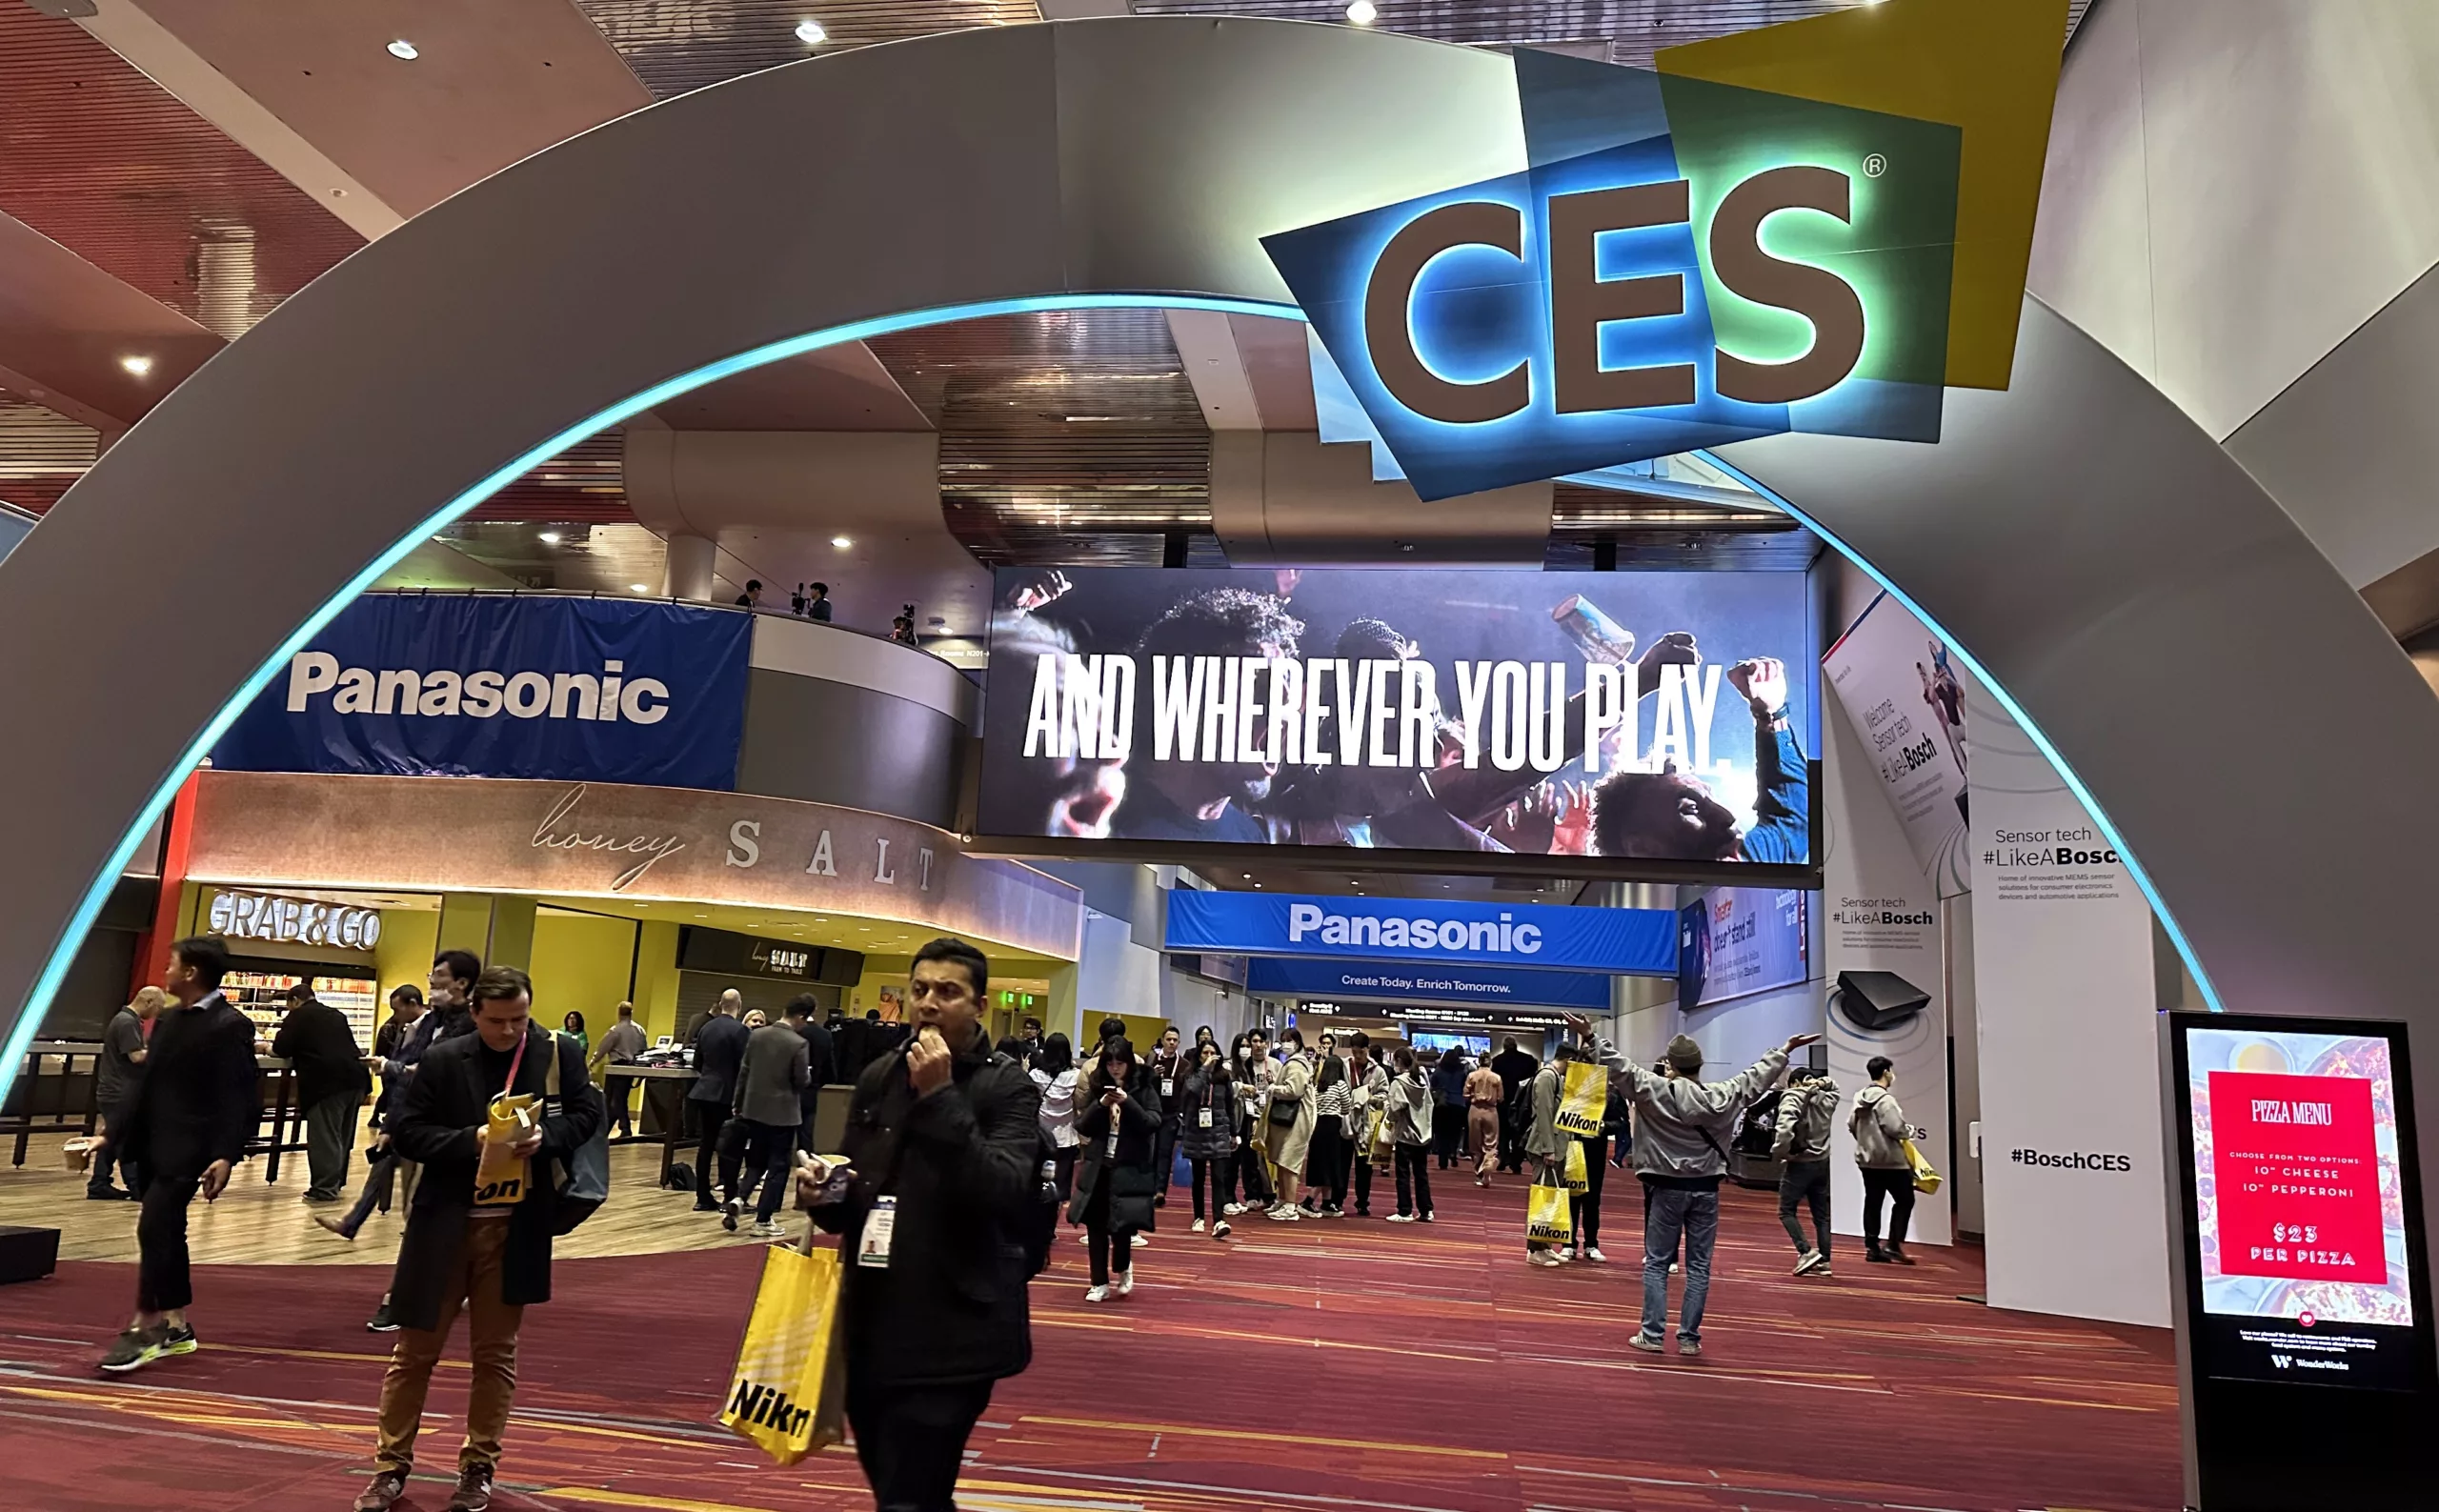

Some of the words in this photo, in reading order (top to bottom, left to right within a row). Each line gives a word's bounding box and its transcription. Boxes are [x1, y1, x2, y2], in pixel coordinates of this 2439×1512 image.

[1363, 164, 1865, 424] CES
[287, 652, 670, 725] Panasonic
[1022, 654, 1137, 759] AND
[1152, 655, 1436, 768] WHEREVER
[1454, 660, 1566, 772] YOU
[1583, 662, 1732, 775] PLAY.
[1863, 698, 1895, 730] Welcome
[1872, 722, 1899, 753] Sensor
[1894, 712, 1913, 740] tech
[1881, 733, 1938, 783] #LikeABosch
[532, 783, 686, 892] honey
[726, 820, 934, 892] SALT
[1995, 829, 2051, 843] Sensor
[2056, 827, 2092, 841] tech
[1983, 847, 2123, 867] #LikeABosc
[1841, 897, 1879, 908] Sensor
[1882, 897, 1905, 907] tech
[209, 890, 301, 941] GRAB
[305, 903, 330, 946] &
[336, 907, 381, 951] GO
[1289, 903, 1542, 954] Panasonic
[1833, 911, 1933, 925] #LikeABosch
[1341, 975, 1378, 986] Create
[1380, 977, 1414, 990] Today.
[1417, 978, 1452, 990] Enrich
[1453, 980, 1511, 994] Tomorrow.
[1557, 1111, 1599, 1132] Nikon
[2251, 1099, 2291, 1124] PIZZA
[2291, 1101, 2332, 1126] MENU
[2011, 1149, 2131, 1172] #BoschCES
[2229, 1151, 2265, 1159] CHOOSE
[2282, 1167, 2339, 1179] CHEESE
[1562, 1178, 1586, 1190] kon
[2271, 1184, 2353, 1198] PEPPERONI
[1529, 1224, 1570, 1240] Nikon
[2272, 1222, 2318, 1243] $23
[2250, 1246, 2288, 1262] PER
[2297, 1249, 2356, 1266] PIZZA
